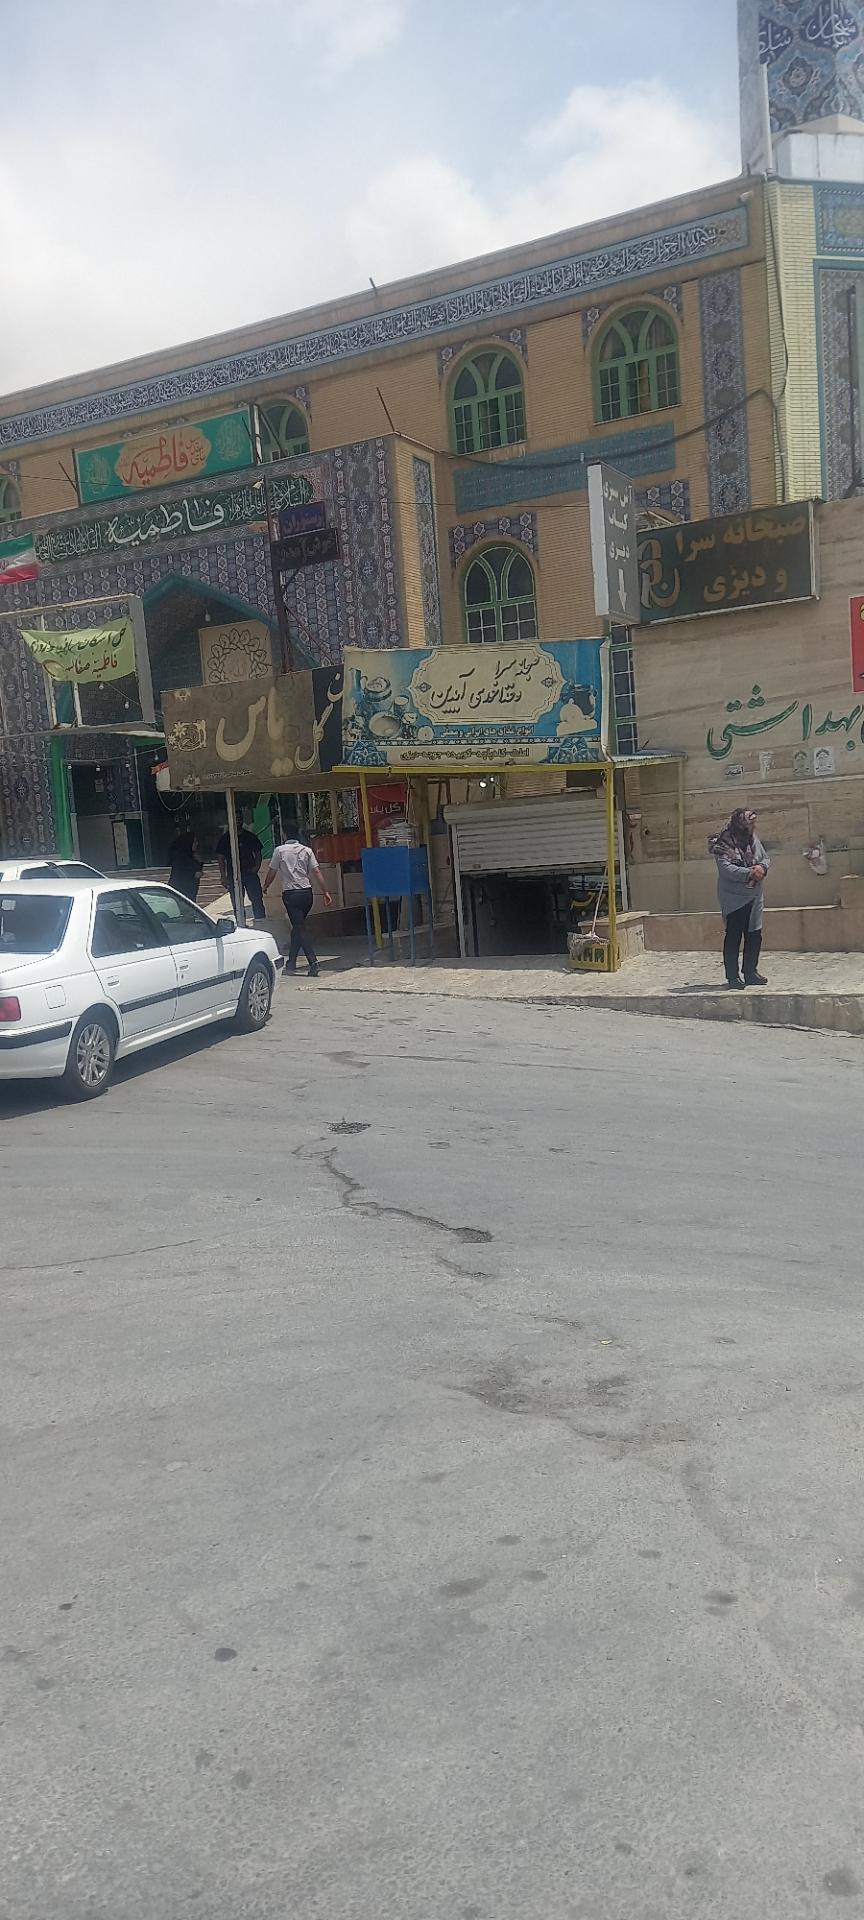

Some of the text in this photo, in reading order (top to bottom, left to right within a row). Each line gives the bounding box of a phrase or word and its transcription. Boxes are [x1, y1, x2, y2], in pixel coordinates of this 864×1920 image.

[608, 507, 629, 535] کباب
[675, 515, 806, 562] صبحانه سرا
[703, 565, 767, 603] دیزی
[774, 568, 788, 592] و
[494, 659, 517, 682] سرا
[215, 686, 294, 778] یاس
[294, 702, 333, 772] گل
[707, 683, 863, 761] بهداشتی
